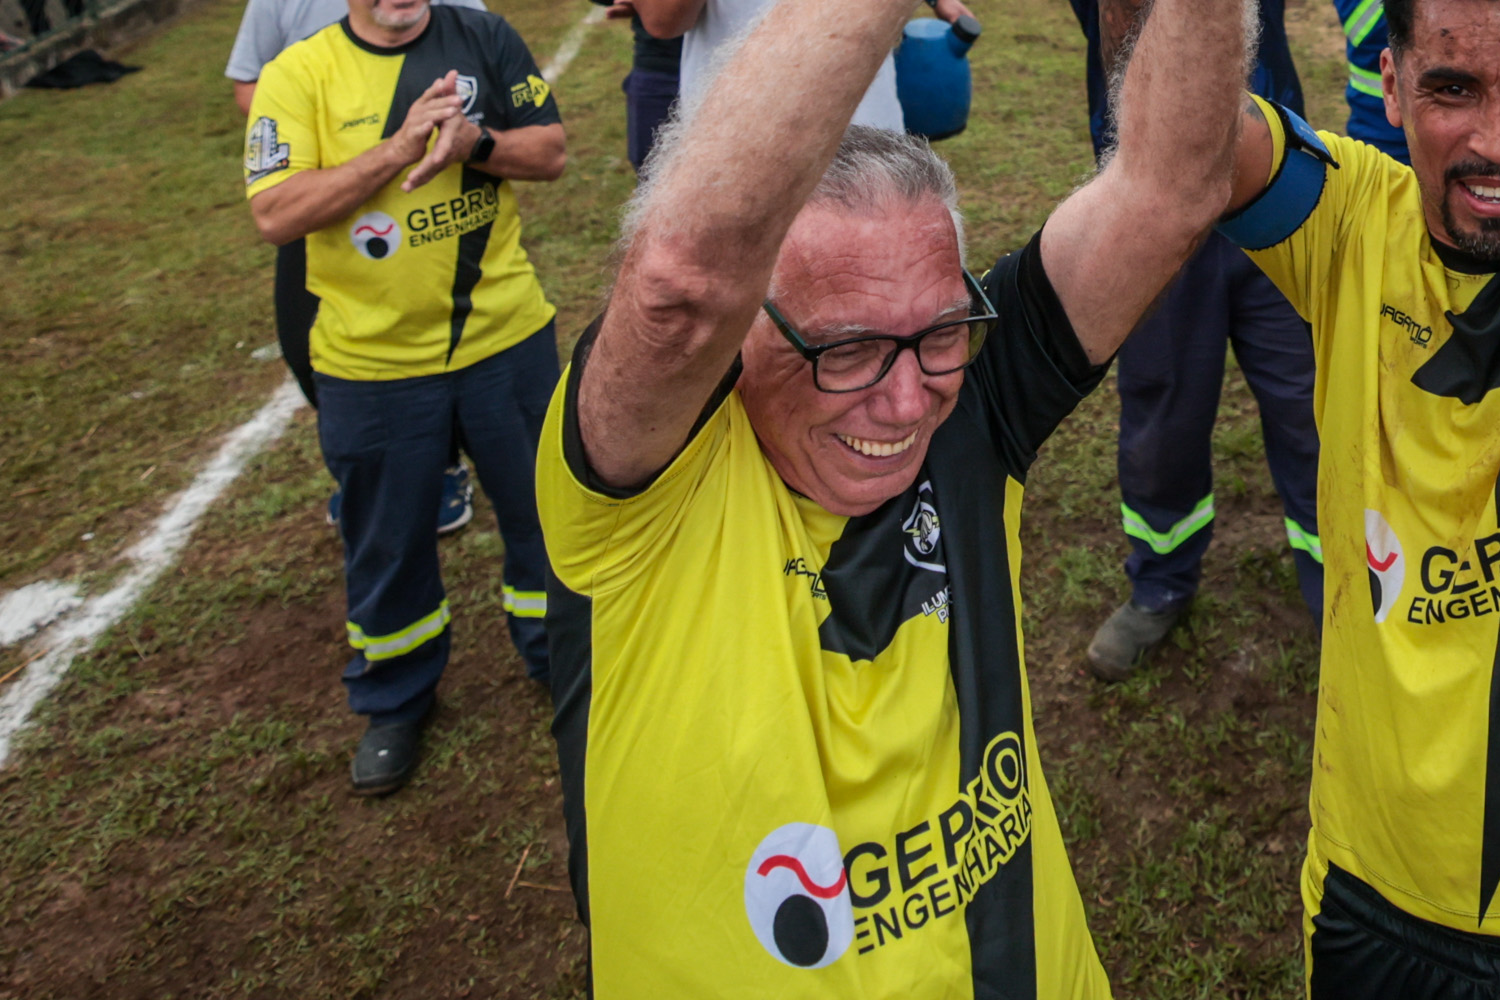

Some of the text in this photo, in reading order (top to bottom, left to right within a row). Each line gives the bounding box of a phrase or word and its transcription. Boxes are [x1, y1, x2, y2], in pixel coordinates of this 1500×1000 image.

[407, 183, 496, 232] GEPRO
[409, 206, 499, 248] ENGENHARIA
[843, 734, 1024, 909] GEPRO
[854, 790, 1034, 956] ENGENHARIA
